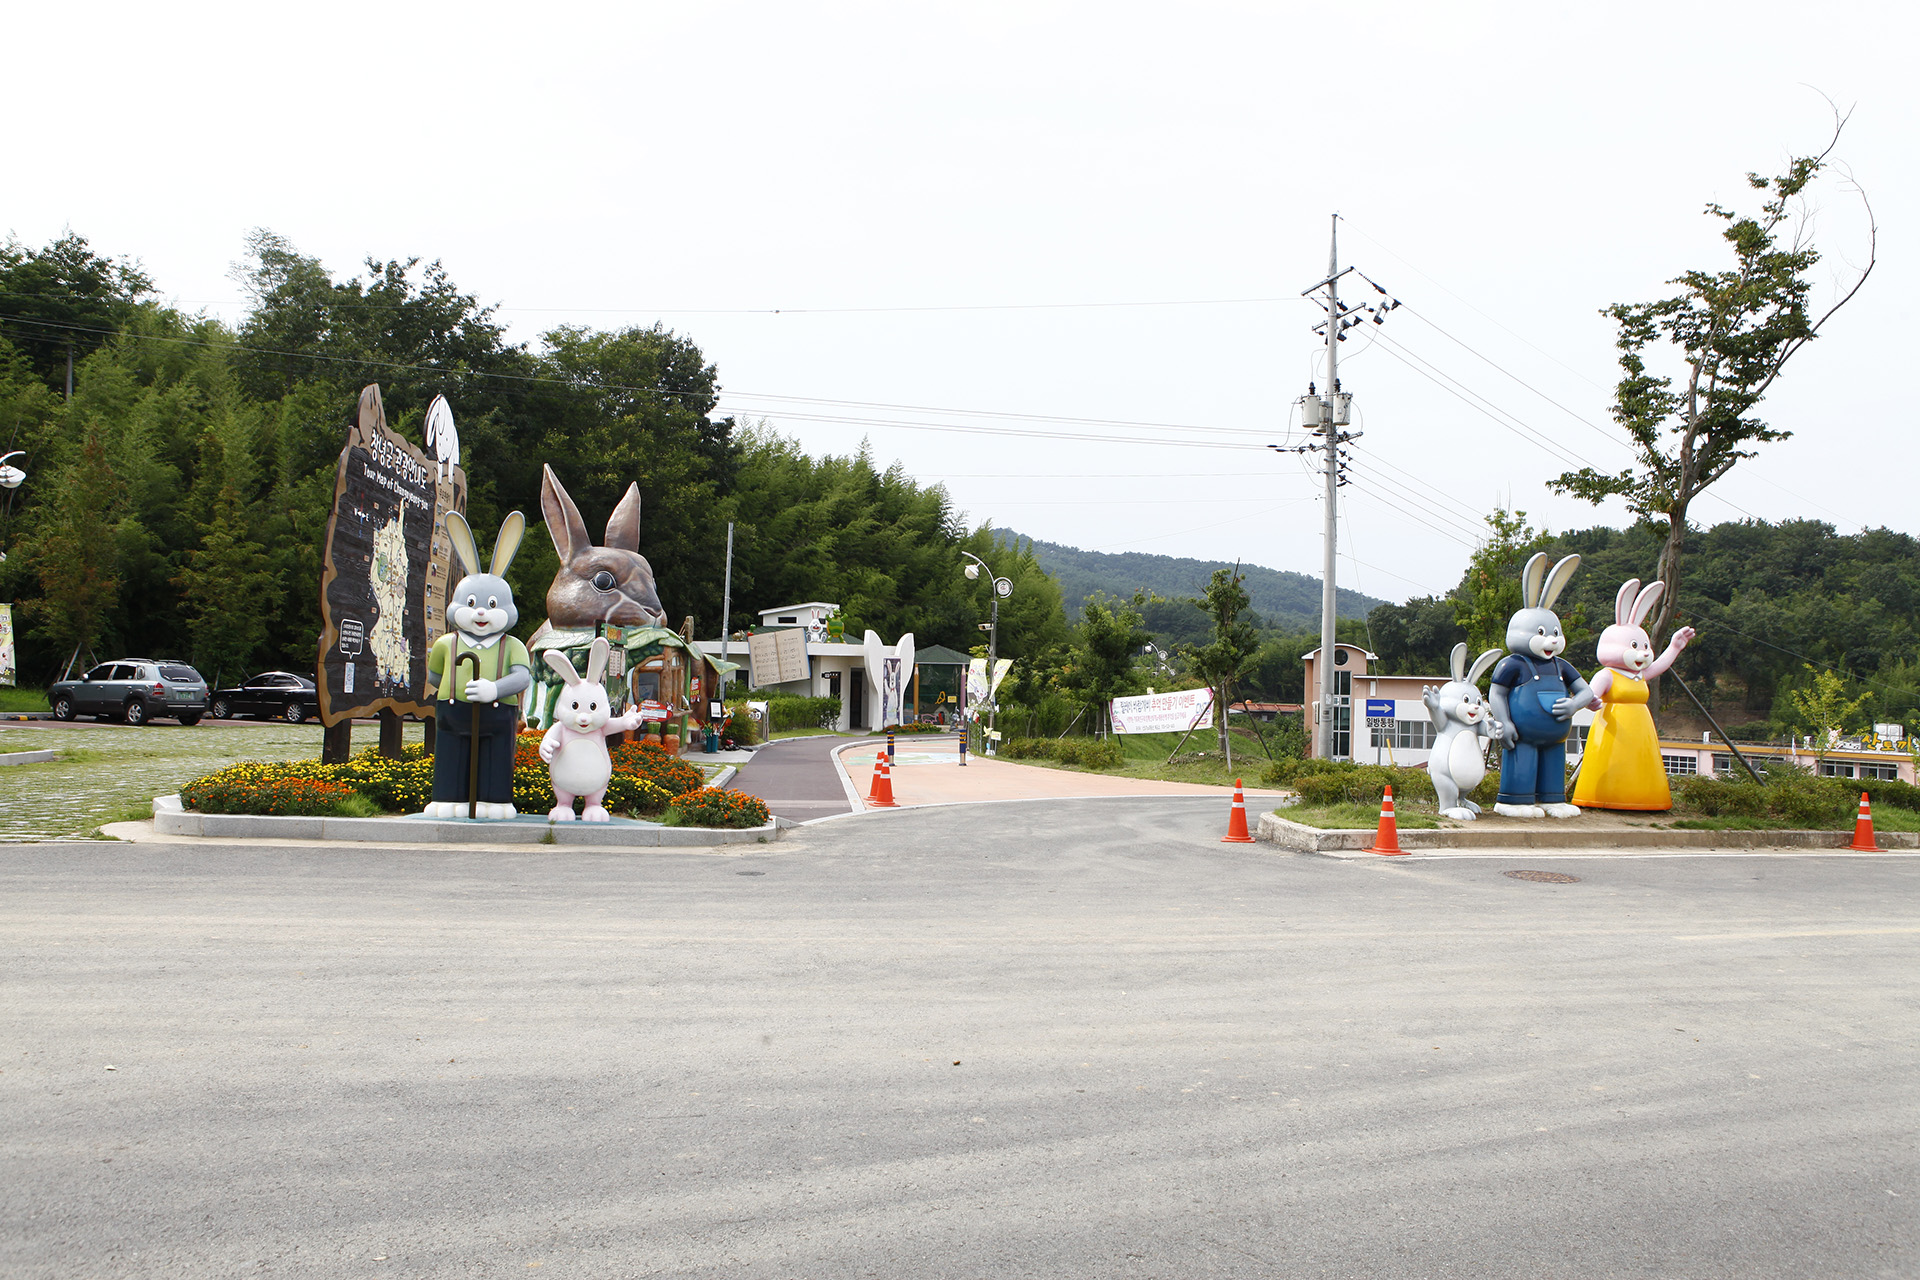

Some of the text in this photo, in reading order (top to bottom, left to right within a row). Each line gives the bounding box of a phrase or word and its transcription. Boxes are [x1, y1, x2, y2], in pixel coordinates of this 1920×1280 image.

[370, 428, 427, 490] 창녕군 관광안내도
[363, 462, 376, 480] Tour
[376, 470, 388, 489] Map
[386, 478, 394, 490] of
[1151, 698, 1161, 711] 추억
[1162, 695, 1178, 711] 만들기
[1178, 694, 1196, 709] 이벤트
[1366, 717, 1395, 728] 일방통행
[1861, 732, 1912, 752] 산토끼
